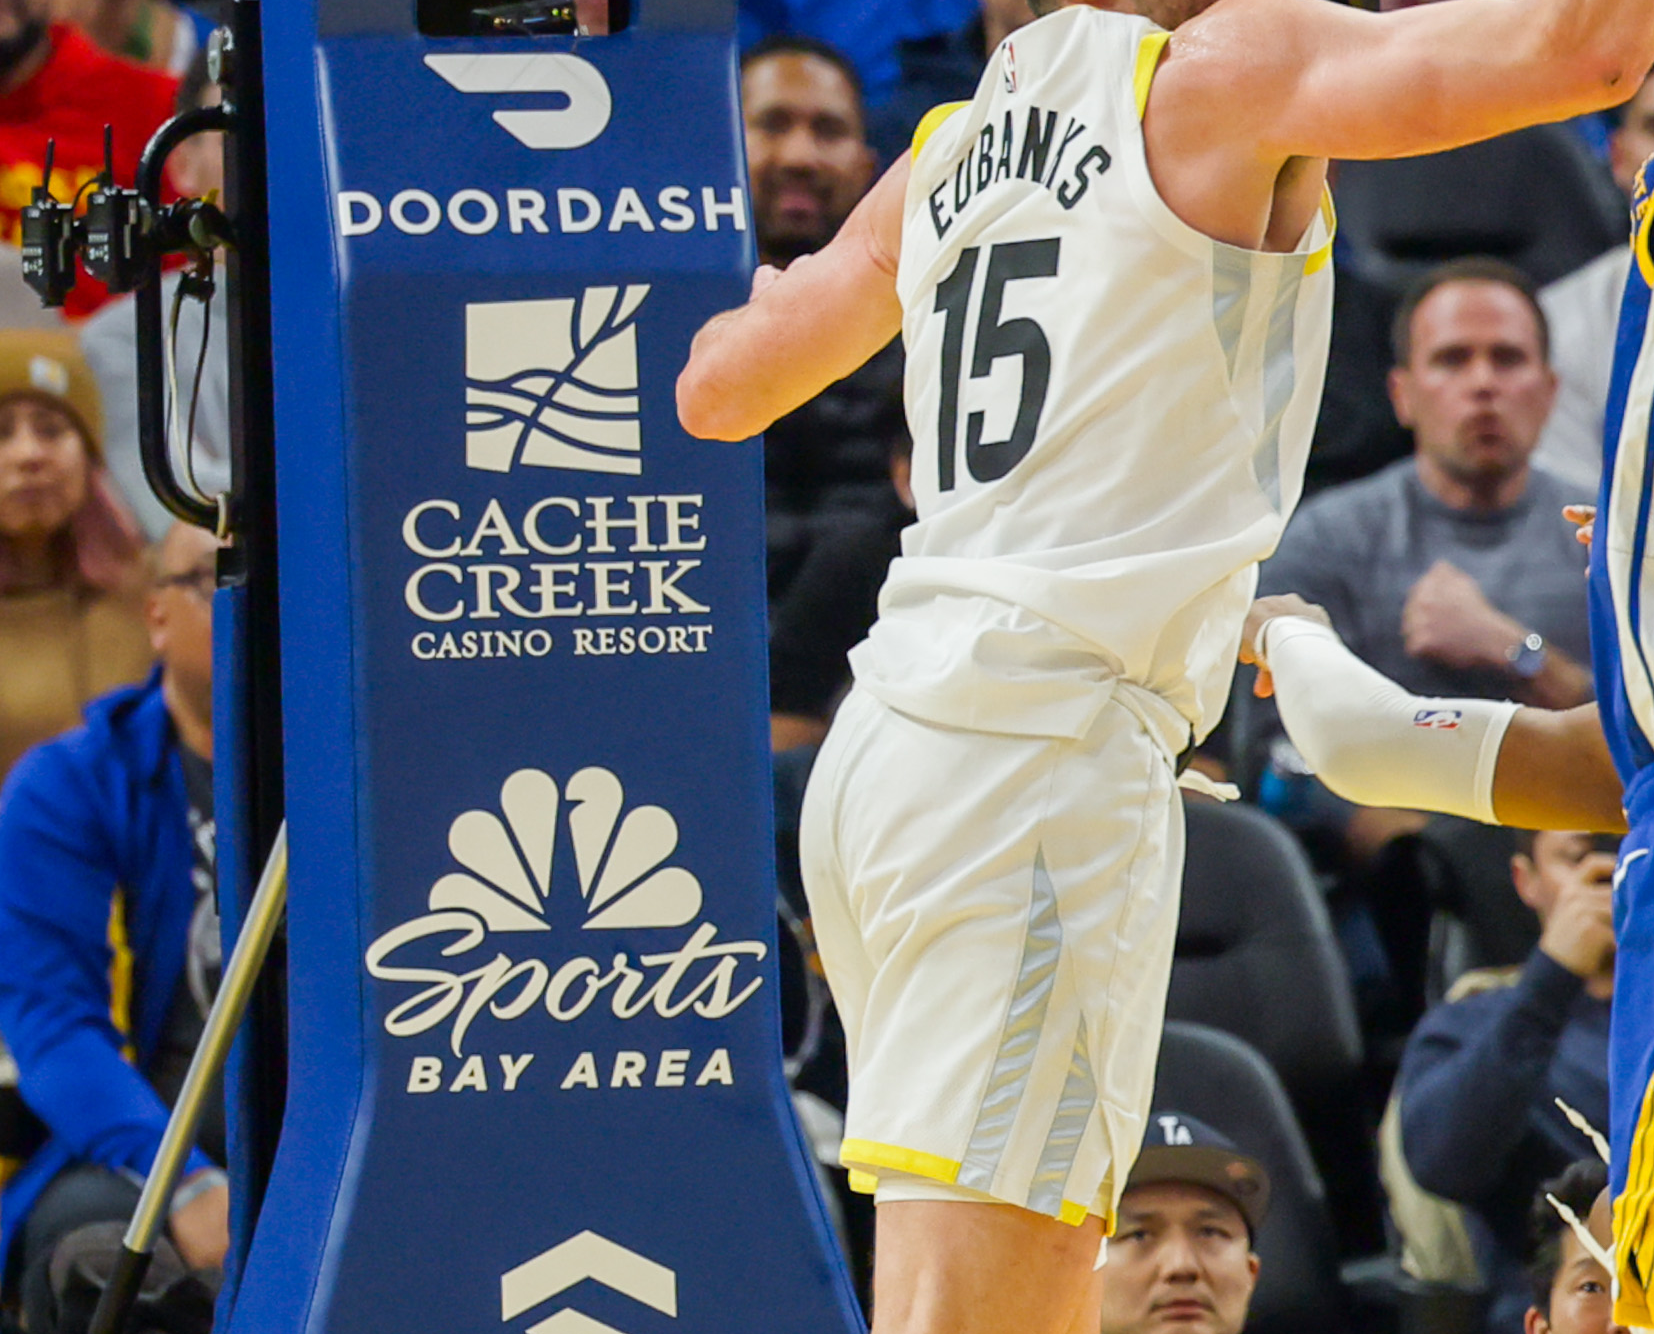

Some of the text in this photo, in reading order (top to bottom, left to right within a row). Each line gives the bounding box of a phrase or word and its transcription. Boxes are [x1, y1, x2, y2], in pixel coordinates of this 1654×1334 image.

[928, 105, 1112, 241] EUBANKS
[338, 186, 748, 237] DOORDASH
[932, 236, 1062, 493] 15
[402, 494, 707, 558] CACHE
[404, 559, 711, 622] CREEK
[411, 624, 713, 660] CASINO RESORT
[366, 911, 768, 1058] Sports
[406, 1048, 734, 1094] BAY AREA
